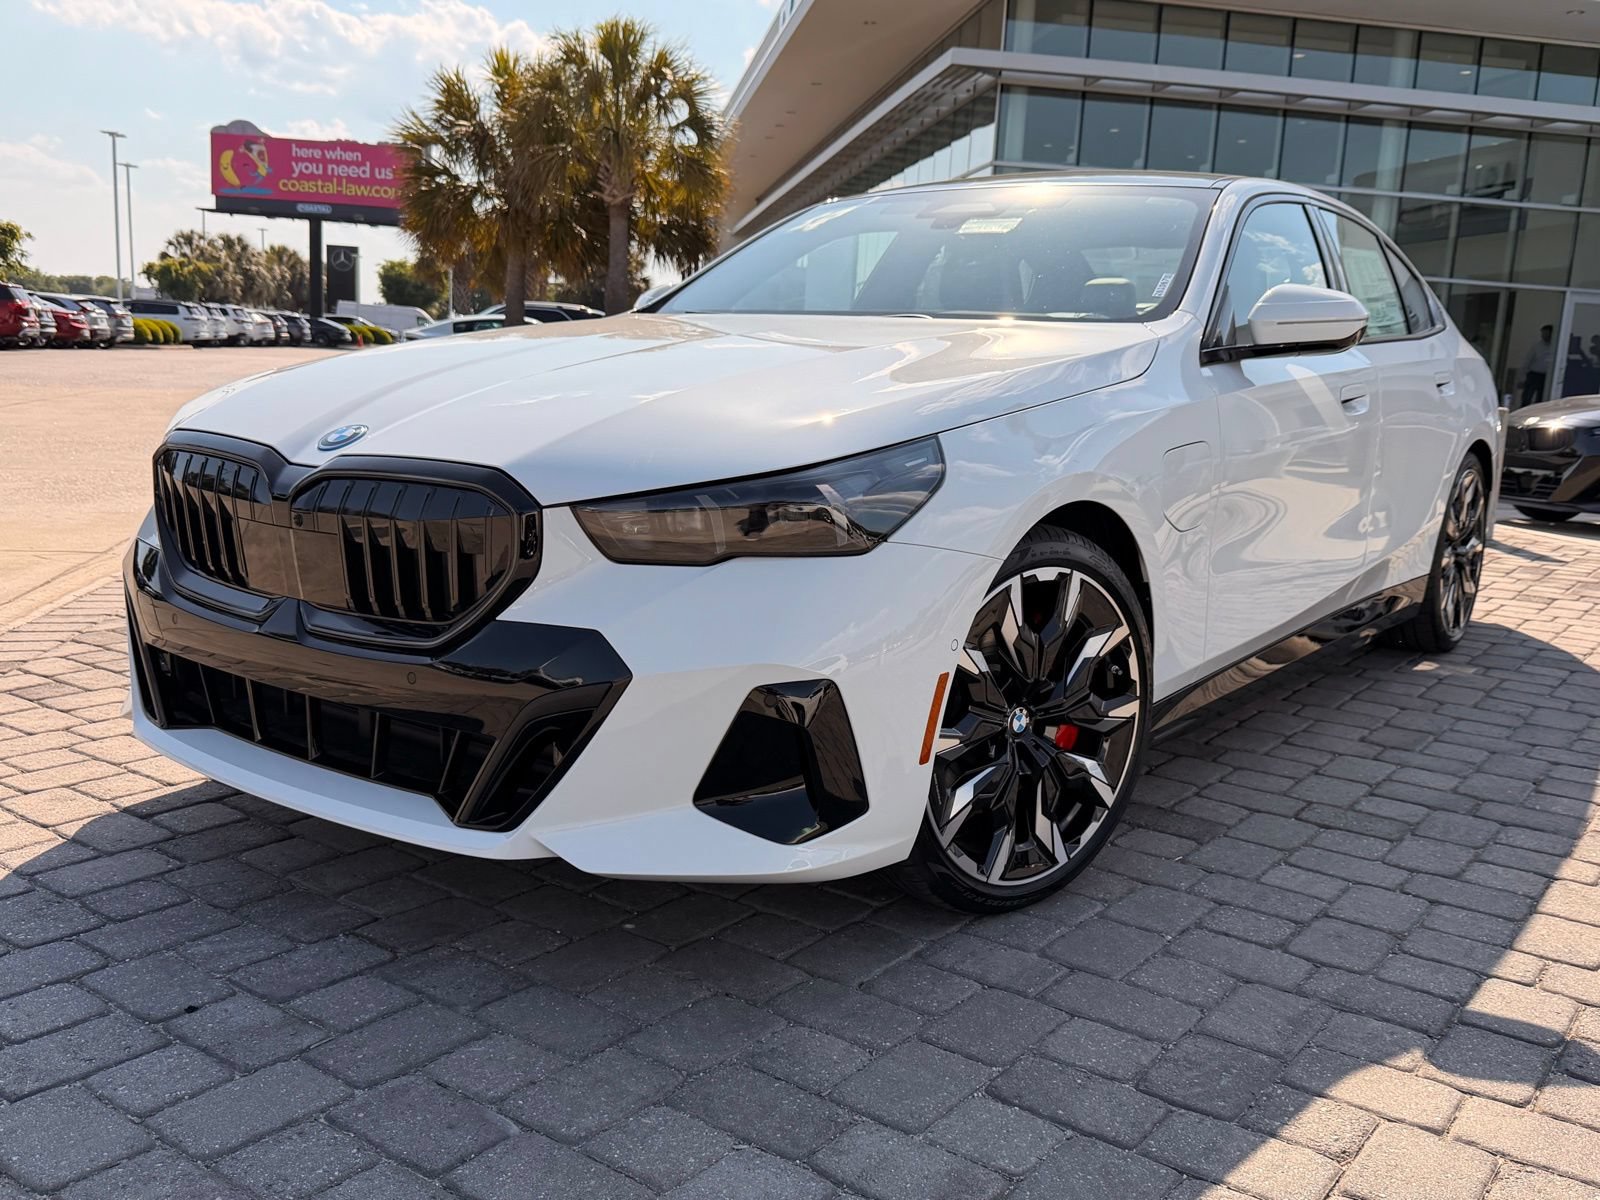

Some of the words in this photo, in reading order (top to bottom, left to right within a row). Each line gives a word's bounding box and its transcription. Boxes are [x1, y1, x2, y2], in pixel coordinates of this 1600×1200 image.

[291, 143, 322, 159] here
[324, 146, 362, 162] when
[291, 161, 323, 178] you
[327, 161, 371, 179] need
[375, 167, 394, 180] us
